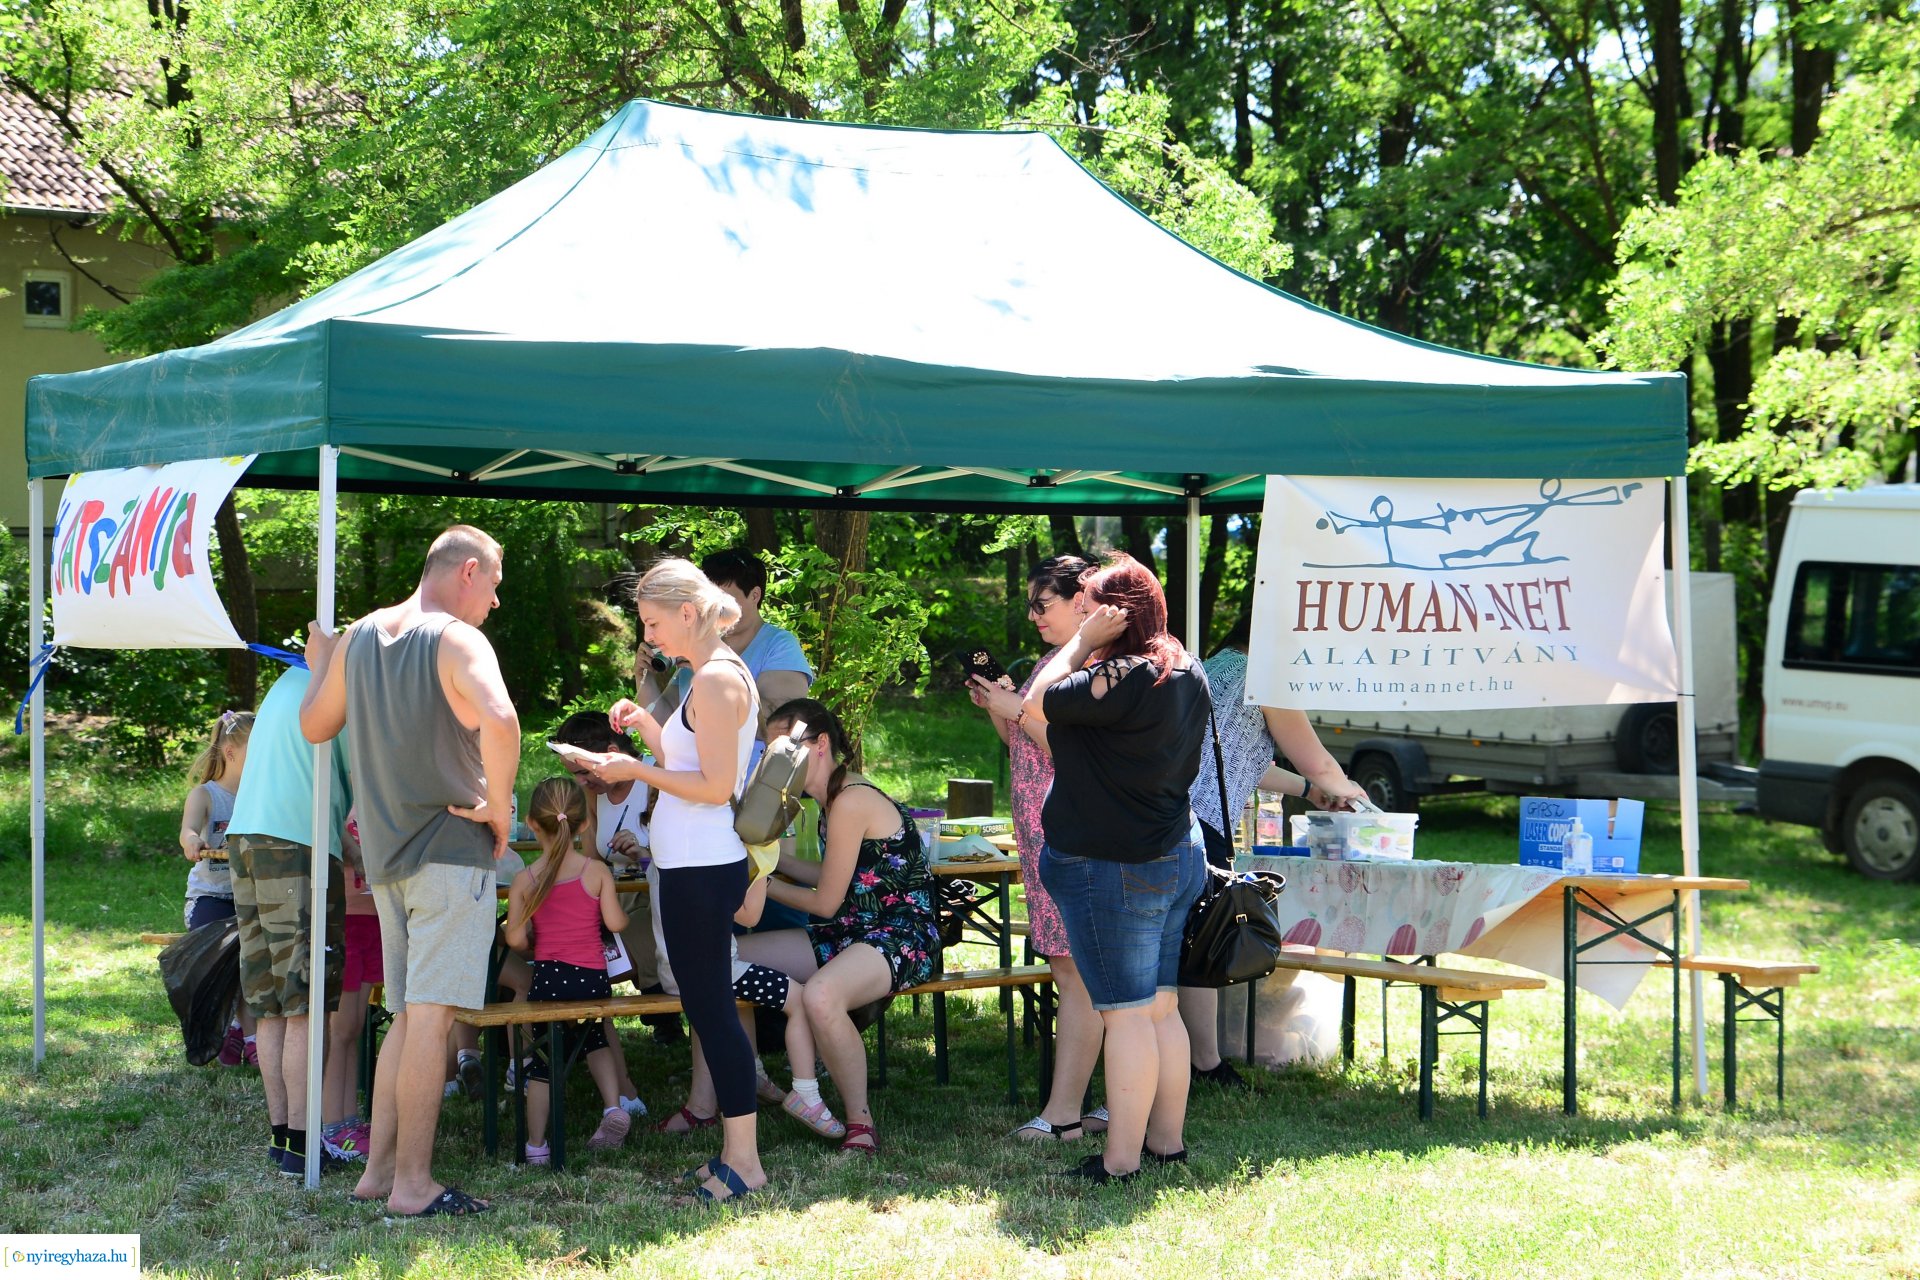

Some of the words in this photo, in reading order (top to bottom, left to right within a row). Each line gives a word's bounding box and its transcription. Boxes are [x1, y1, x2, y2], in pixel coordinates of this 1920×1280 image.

[1293, 576, 1572, 634] HUMAN-NET
[1290, 641, 1578, 667] ALAPÍTVÁNY
[1288, 676, 1514, 694] www.humannet.hu
[982, 823, 1008, 834] SCRABBLE
[1524, 822, 1548, 841] LASER
